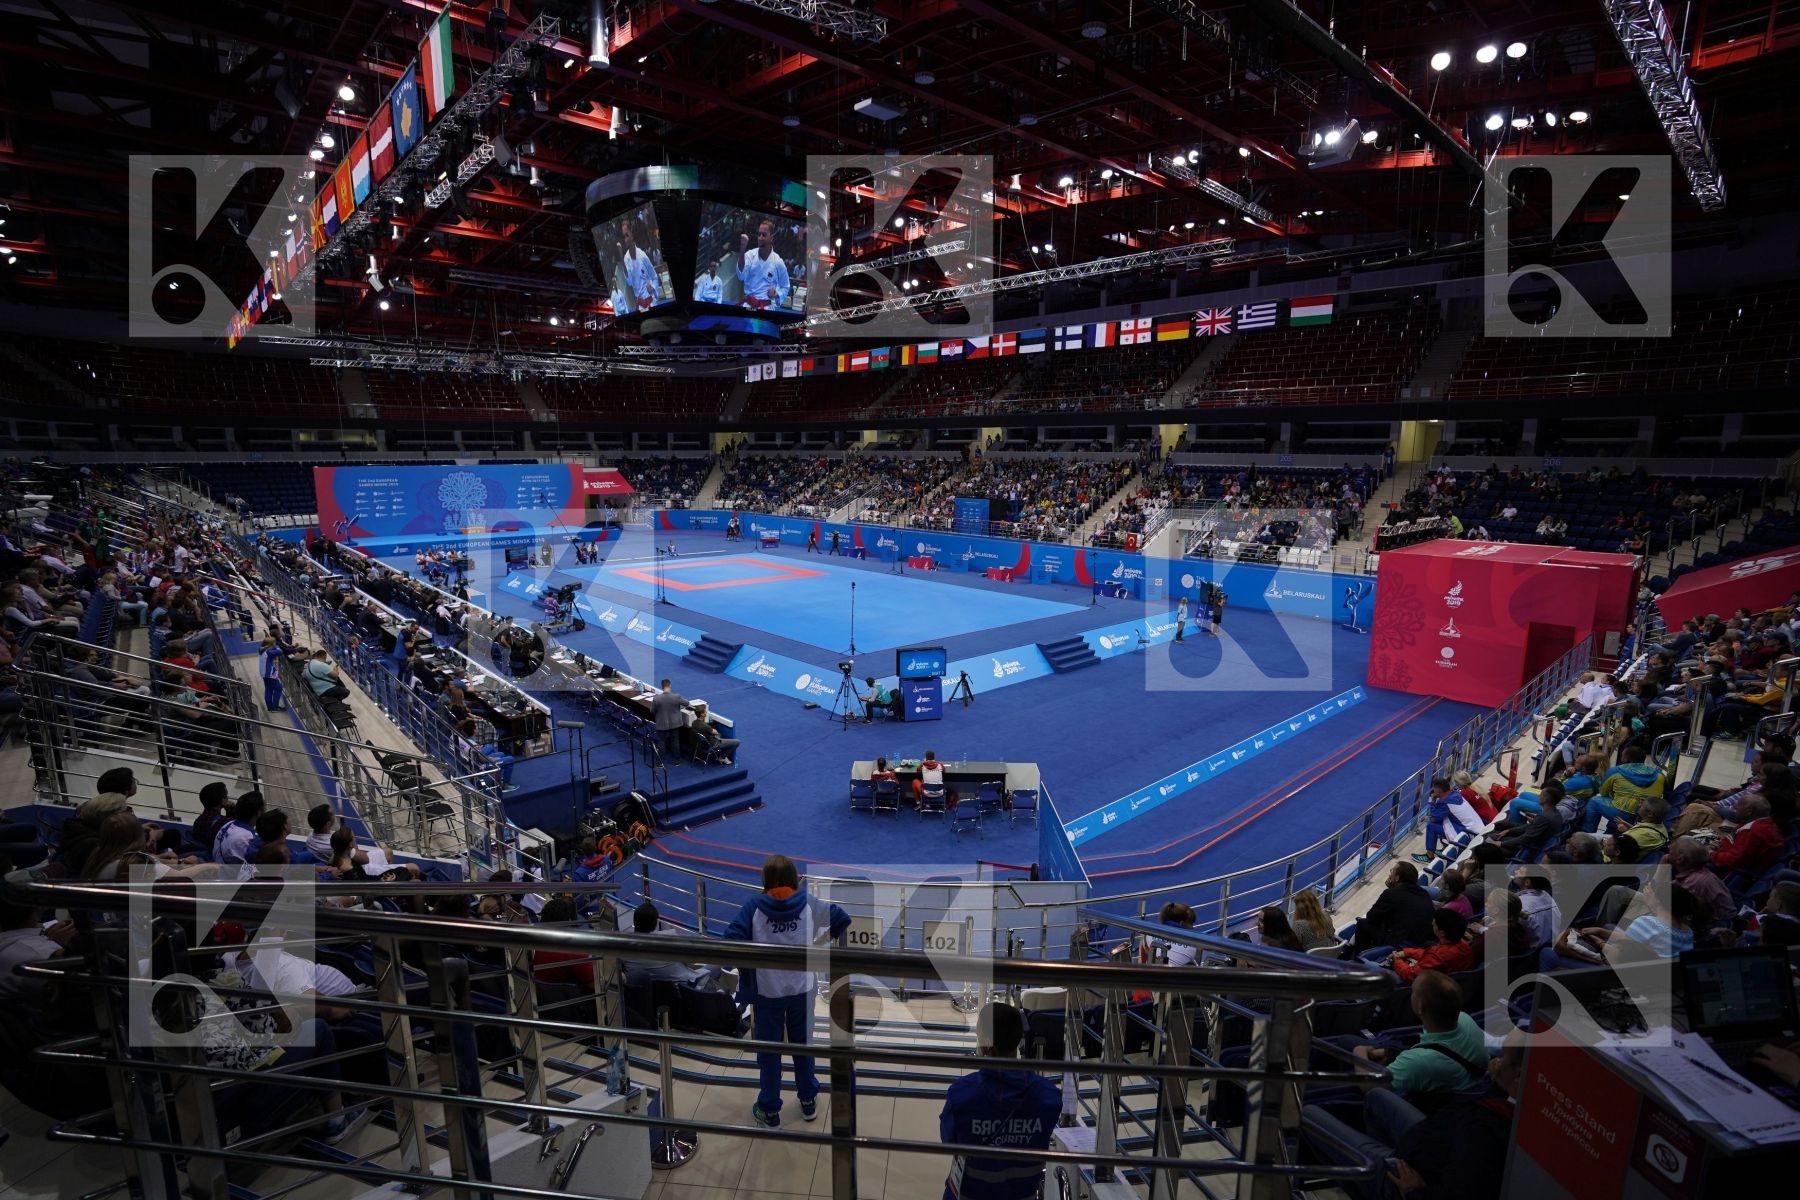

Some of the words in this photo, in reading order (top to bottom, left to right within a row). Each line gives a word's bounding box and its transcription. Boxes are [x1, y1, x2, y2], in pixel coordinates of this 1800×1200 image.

[1283, 589, 1326, 601] BELARUSKALI
[469, 834, 485, 851] 103
[771, 922, 798, 934] 2019
[849, 930, 879, 945] 103
[925, 936, 956, 950] 102
[1537, 1073, 1573, 1109] Press
[1576, 1105, 1616, 1144] Stand
[1553, 1102, 1593, 1140] Трибуна
[1541, 1108, 1561, 1125] для
[1561, 1123, 1600, 1160] прессы
